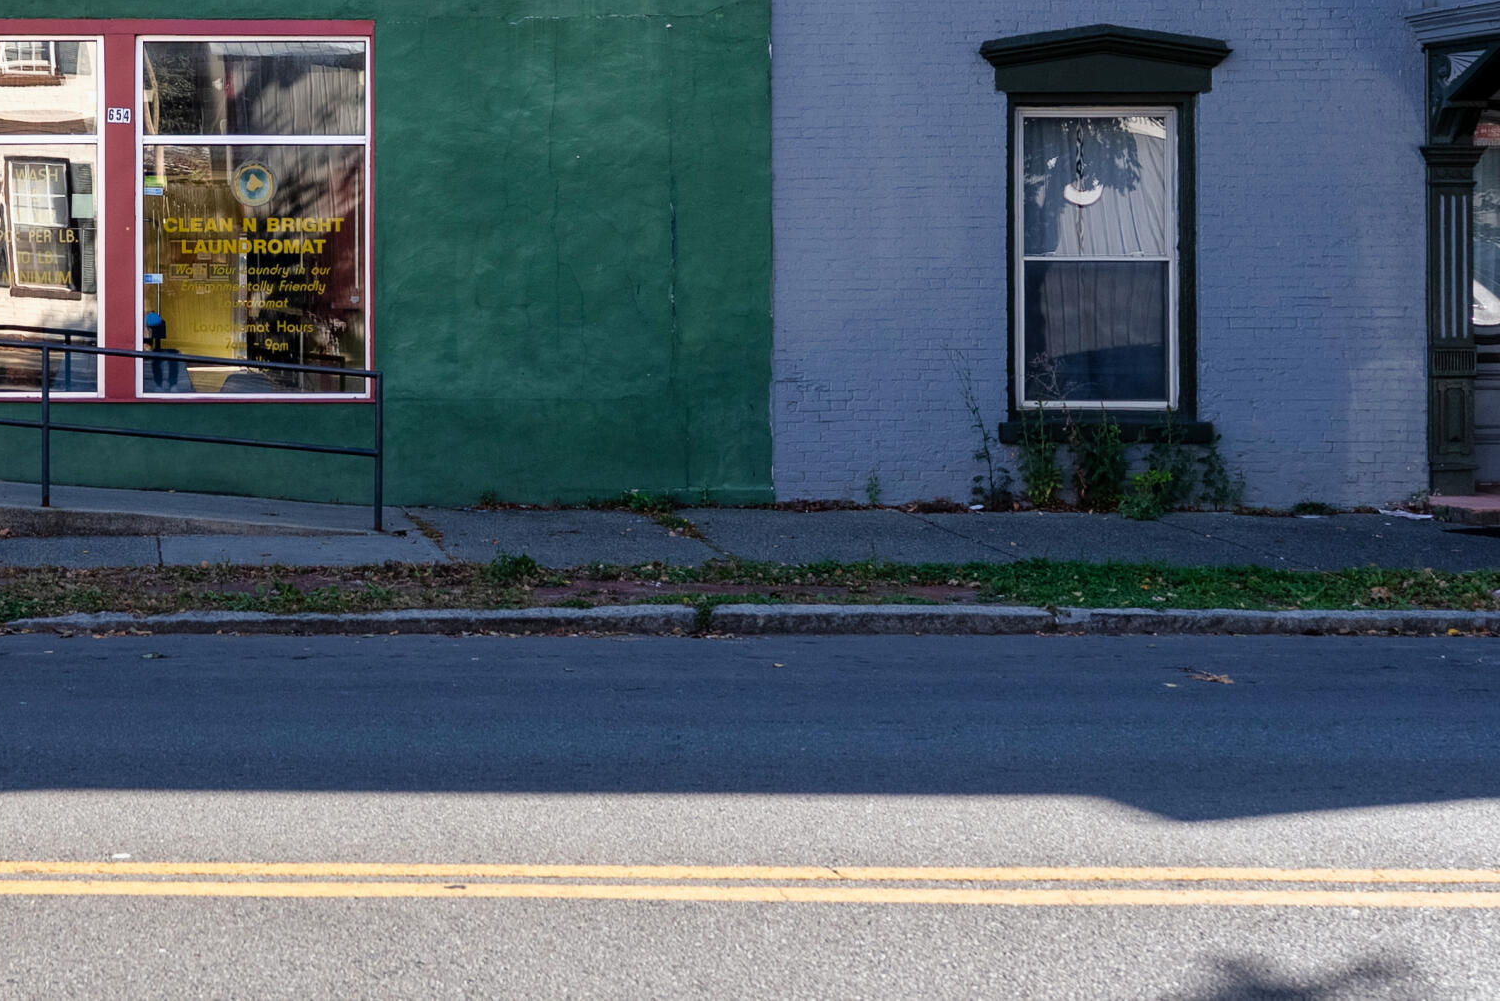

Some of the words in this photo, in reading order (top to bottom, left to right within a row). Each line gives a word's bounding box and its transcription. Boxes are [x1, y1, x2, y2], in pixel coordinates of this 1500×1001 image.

[108, 108, 130, 122] 654
[15, 168, 59, 183] WASH
[163, 217, 233, 233] CLEAN
[242, 217, 257, 233] N
[266, 217, 345, 233] BRIGHT
[28, 229, 52, 243] PER
[59, 228, 79, 243] LB.
[181, 239, 326, 255] LAUNDROMAT
[2, 269, 72, 285] MNIMUM
[175, 264, 207, 275] Wah
[212, 264, 237, 275] Your
[294, 264, 306, 275] in
[311, 266, 332, 276] our
[181, 280, 275, 295] Enronmetally
[278, 280, 327, 295] Friendly
[218, 298, 289, 309] aundromat
[193, 319, 270, 334] Laundmat
[276, 319, 315, 334] Hours
[264, 338, 289, 355] 9pm
